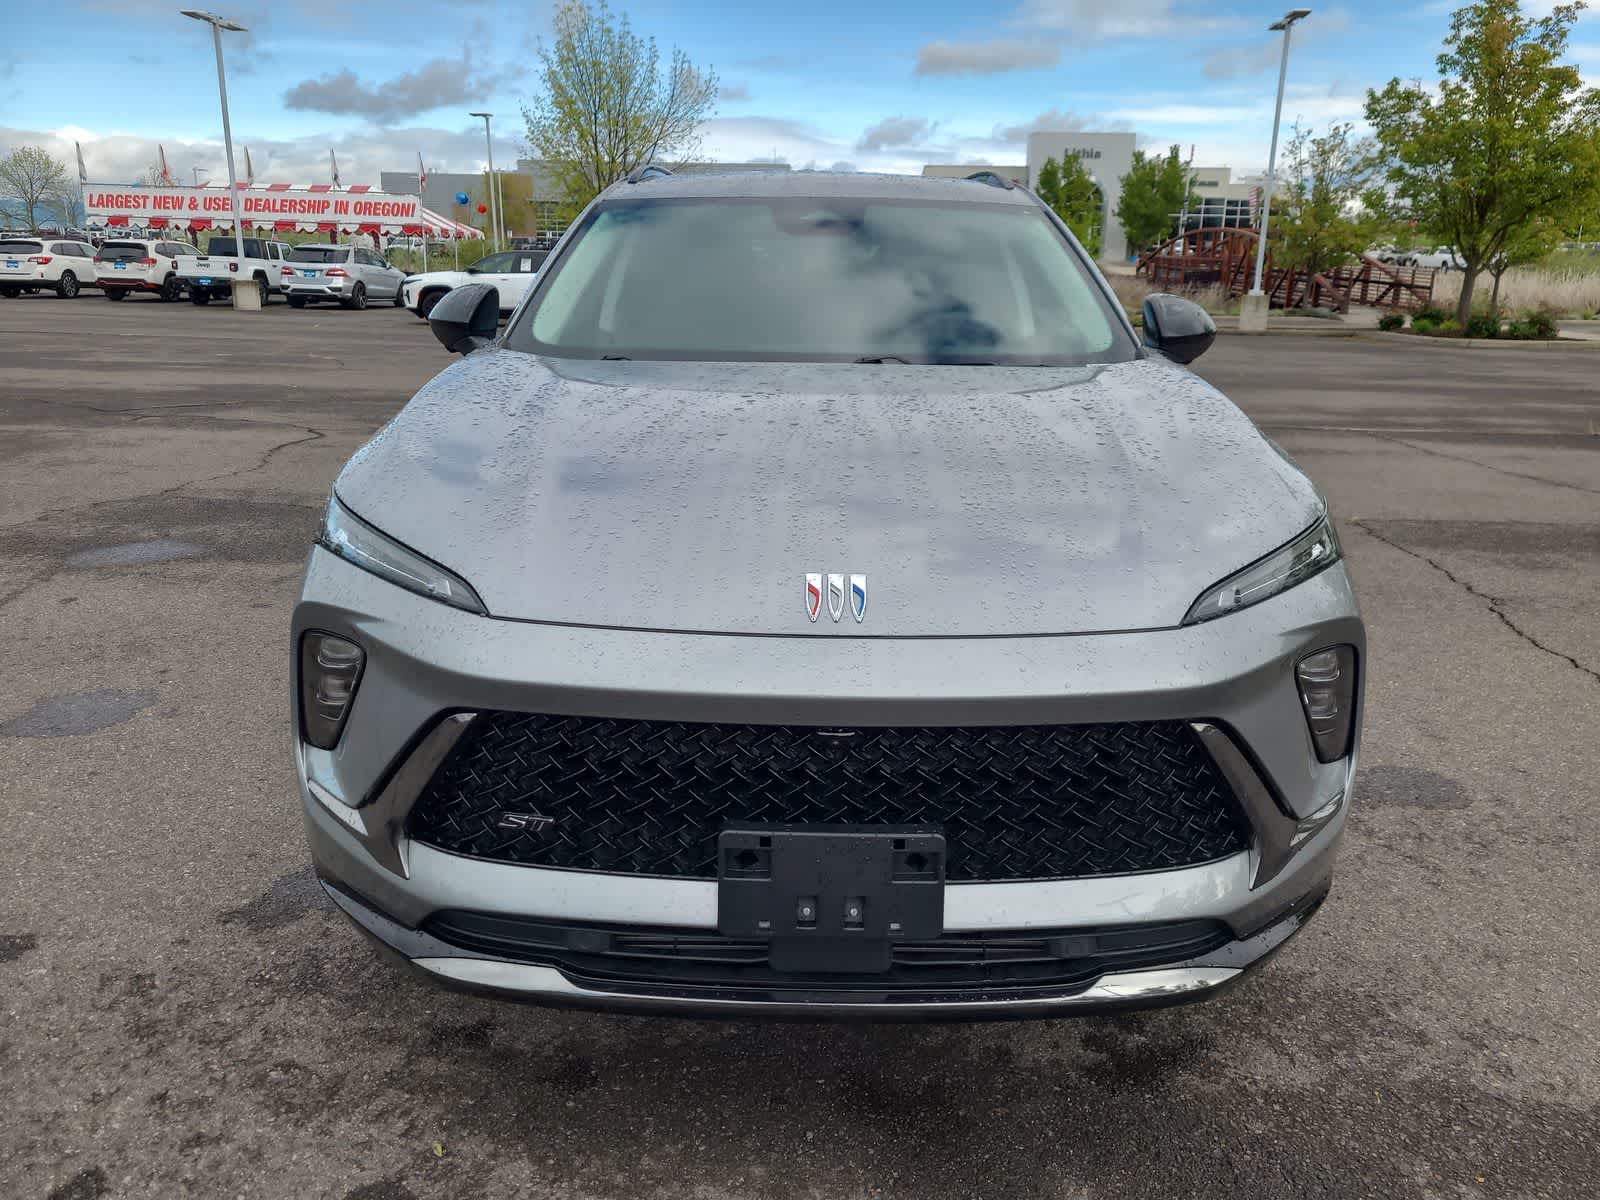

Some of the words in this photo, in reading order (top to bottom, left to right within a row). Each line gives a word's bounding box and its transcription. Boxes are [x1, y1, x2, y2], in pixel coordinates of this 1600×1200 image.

[88, 193, 149, 209] LARGEST
[153, 195, 184, 210] NEW
[188, 196, 199, 211] &
[244, 197, 330, 214] DEALERSHIP
[334, 200, 350, 215] IN
[353, 201, 416, 217] OREGON!
[499, 811, 554, 831] ST
